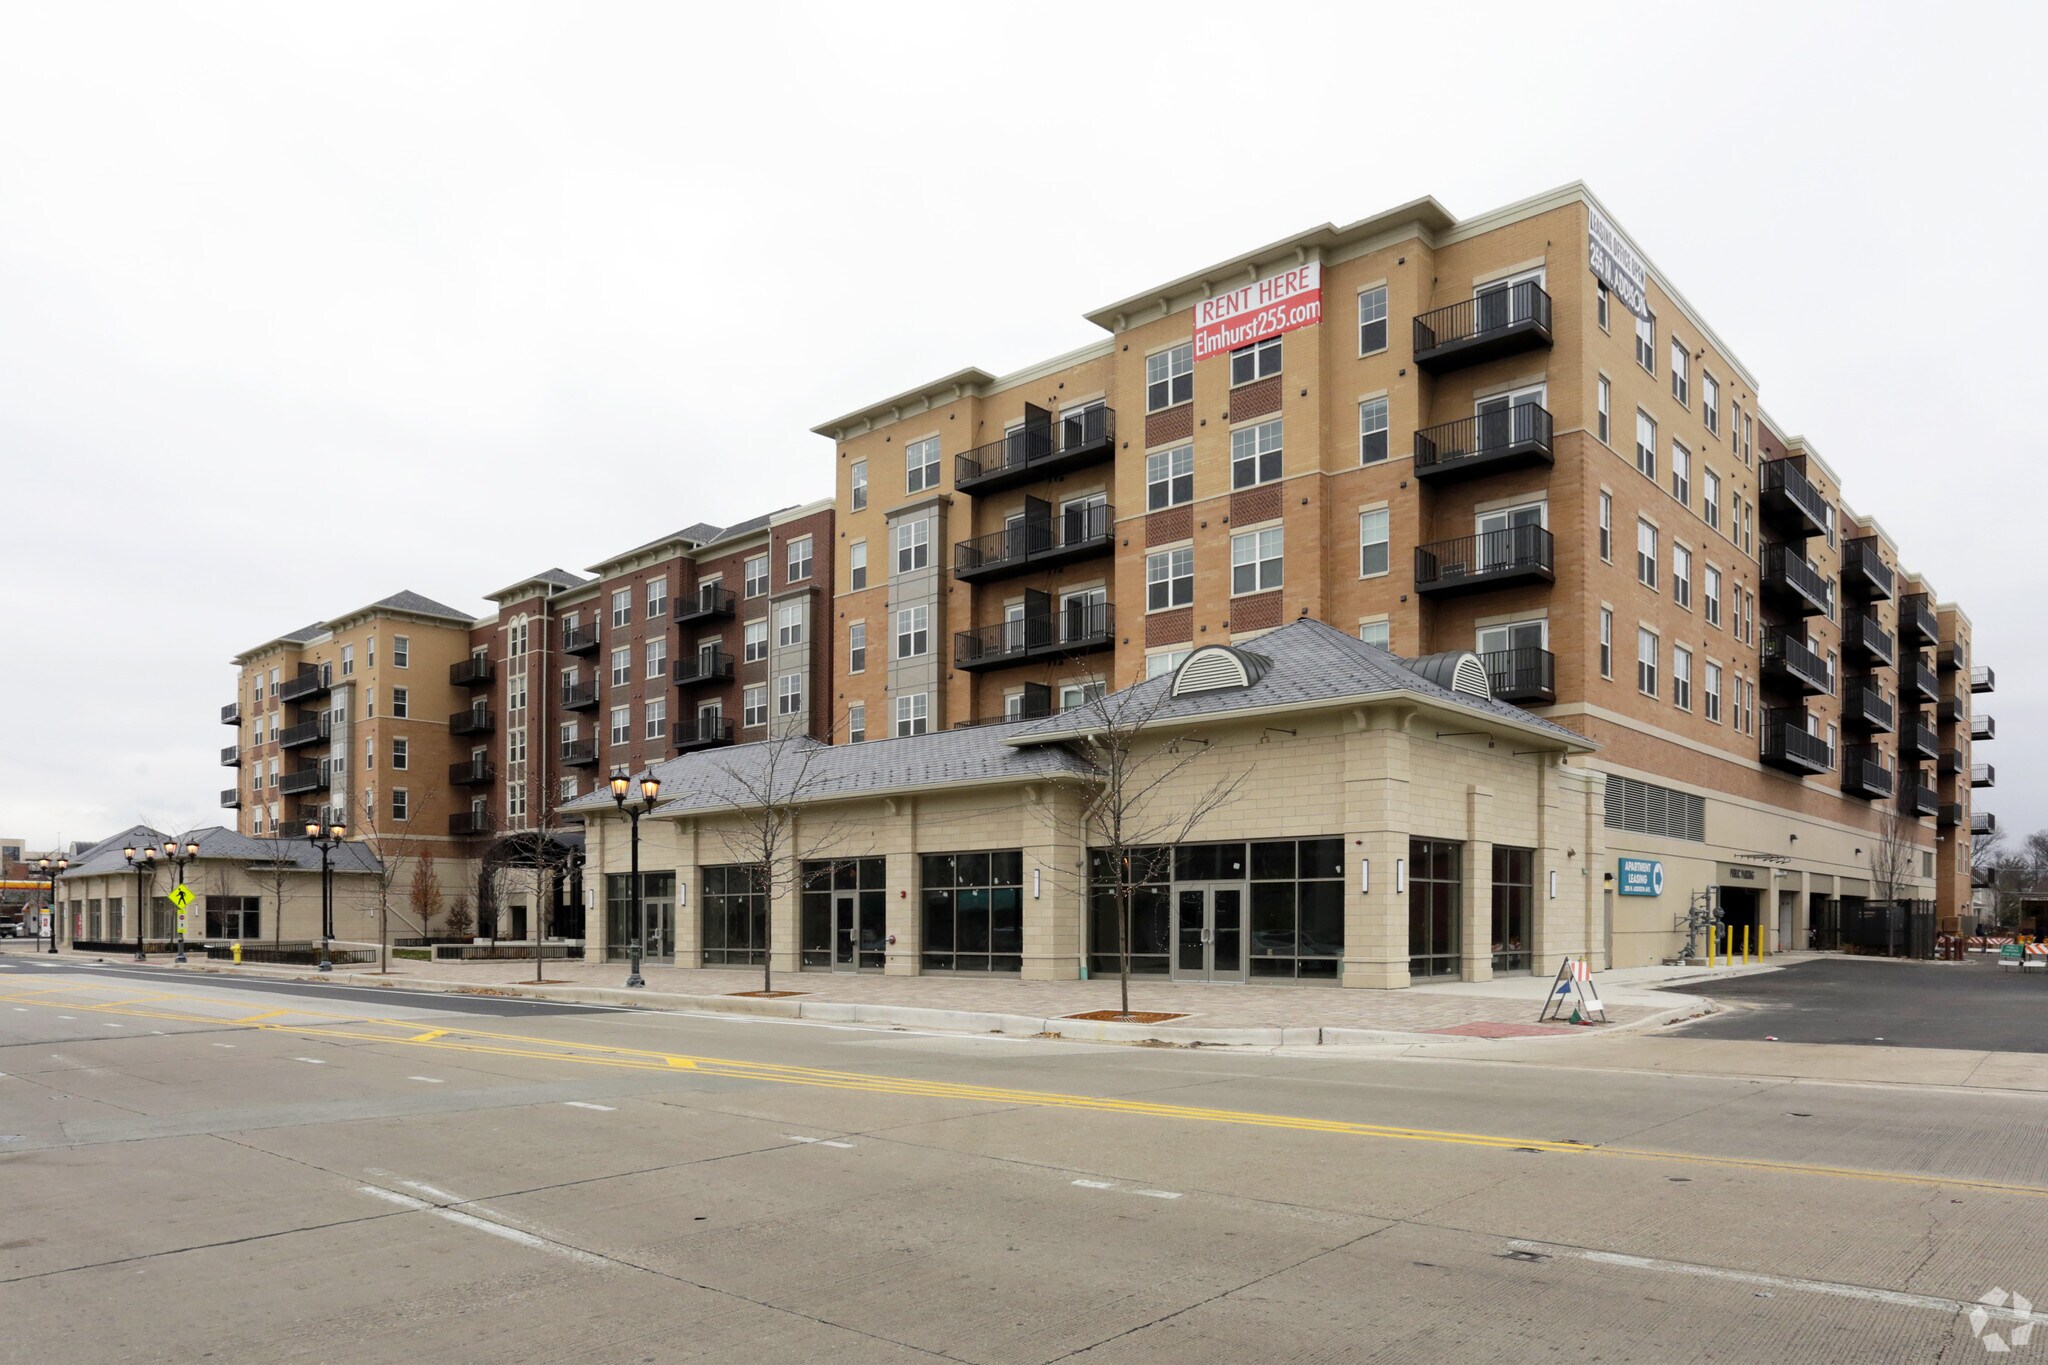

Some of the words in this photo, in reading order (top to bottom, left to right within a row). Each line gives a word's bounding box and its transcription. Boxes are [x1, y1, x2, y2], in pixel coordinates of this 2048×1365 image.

[1590, 210, 1612, 251] LEASING
[1613, 237, 1631, 272] OFFICE
[1202, 286, 1252, 324] RENT
[1259, 265, 1310, 305] HERE
[1590, 242, 1604, 274] 255
[1614, 268, 1648, 318] ADDISON
[1195, 300, 1321, 357] Elmhurst255.com
[1624, 861, 1651, 873] APARTMENT
[1628, 873, 1648, 885] LEASING
